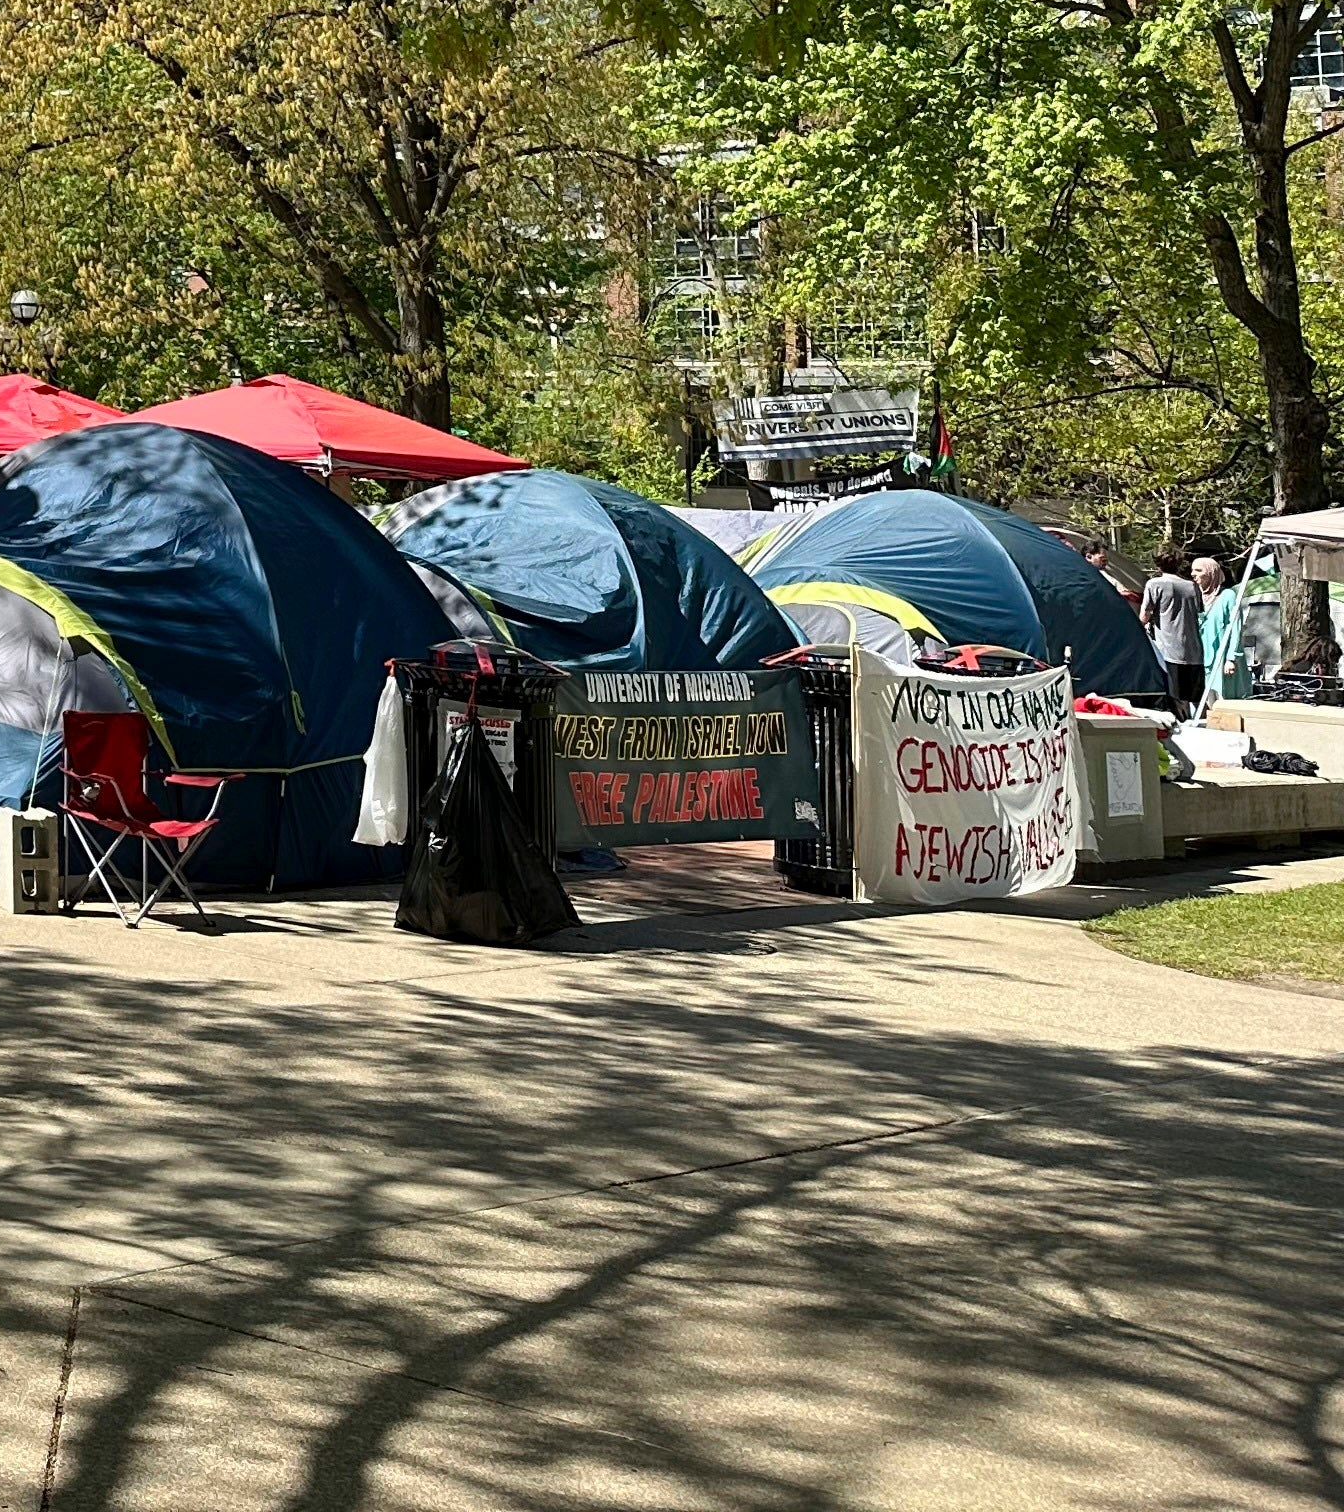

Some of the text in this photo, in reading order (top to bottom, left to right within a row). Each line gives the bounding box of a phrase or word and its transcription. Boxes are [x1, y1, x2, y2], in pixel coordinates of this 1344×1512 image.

[737, 413, 907, 436] NIVERSTY UNIONS
[763, 401, 794, 413] COME
[584, 671, 755, 703] UNIVERSITY OF MICHIGAN:
[891, 674, 1069, 732] NOT IN OUR NAME
[554, 712, 788, 761] VEST FROM ISRAEL NOW
[896, 737, 1017, 794] GENOCIDE
[1016, 738, 1043, 784] IS
[568, 767, 764, 826] FREE PALESTINE
[895, 822, 912, 876] A
[913, 823, 1013, 885] JEWISH
